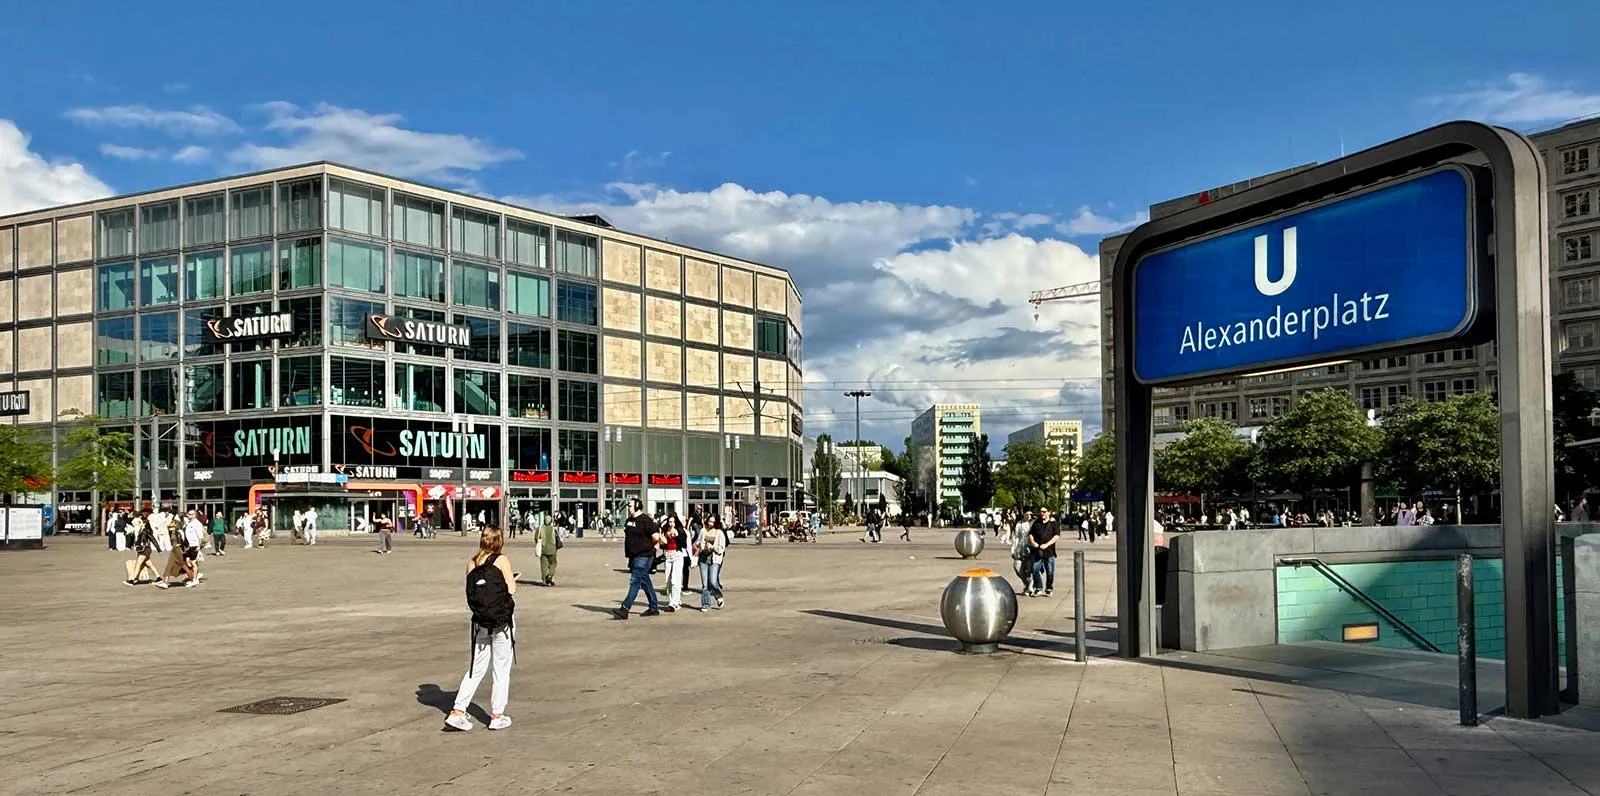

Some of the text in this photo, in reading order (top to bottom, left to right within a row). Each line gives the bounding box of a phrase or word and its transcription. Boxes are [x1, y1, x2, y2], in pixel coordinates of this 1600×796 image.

[1254, 226, 1297, 296] U
[233, 313, 292, 338] SATURN
[405, 320, 471, 347] SATURN
[1179, 292, 1390, 355] Alexanderplatz
[234, 426, 311, 457] SATURN
[399, 429, 486, 459] SATURN
[355, 466, 397, 478] SATURN
